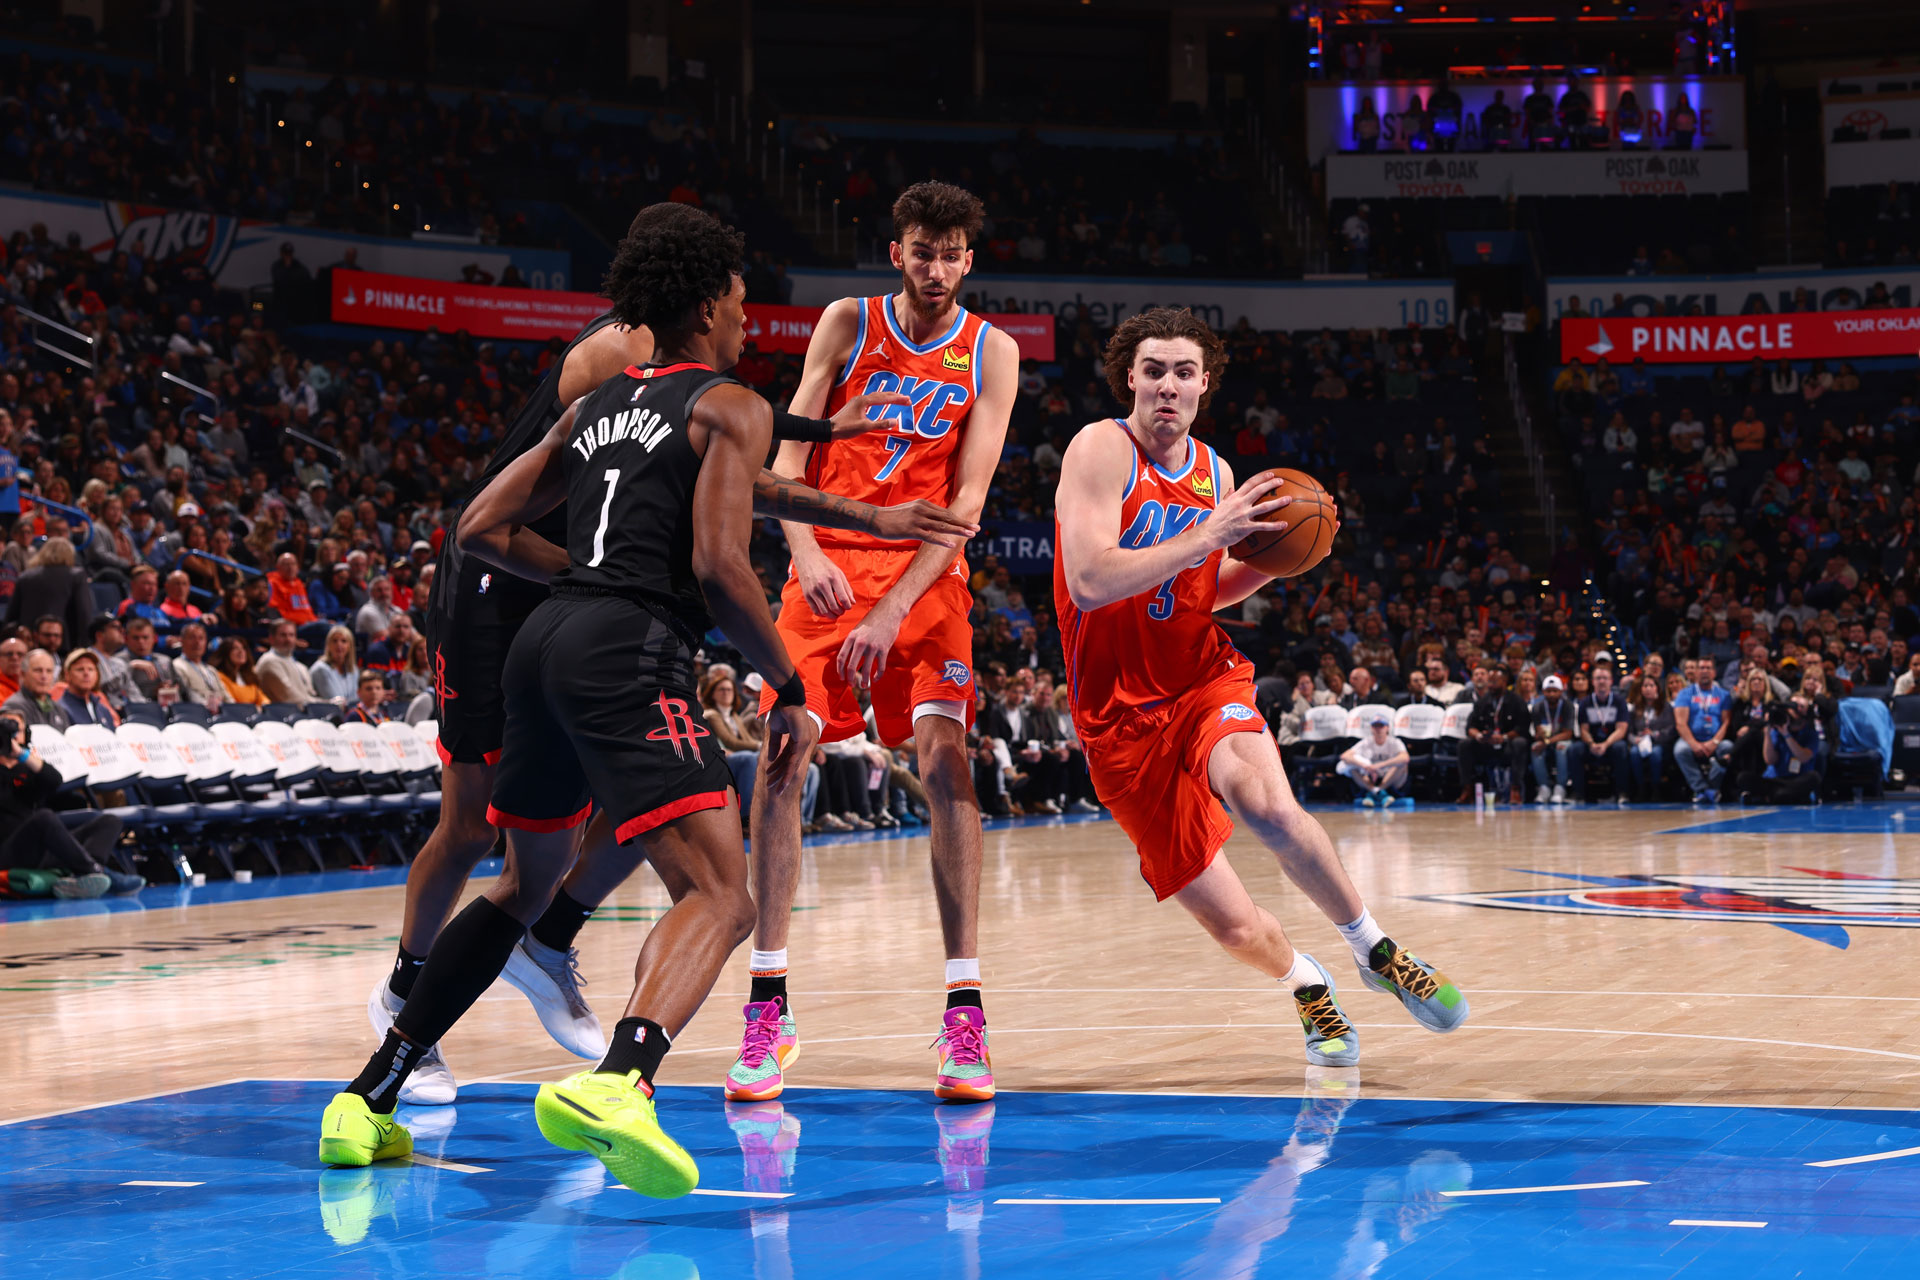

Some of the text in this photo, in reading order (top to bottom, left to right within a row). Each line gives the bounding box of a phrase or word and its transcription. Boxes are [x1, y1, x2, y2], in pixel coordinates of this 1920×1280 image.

[1384, 159, 1479, 181] POST OAK
[1605, 157, 1700, 178] POST OAK
[1396, 183, 1465, 197] TOYOTA
[1618, 179, 1687, 194] TOYOTA
[364, 288, 446, 315] PINNACLE
[1400, 298, 1448, 326] 109
[770, 319, 813, 338] PINN
[1632, 323, 1794, 353] PINNACLE
[1833, 318, 1875, 333] YOUR
[862, 370, 969, 439] OKC
[572, 408, 673, 462] THOMPSON
[873, 435, 912, 481] 7
[587, 468, 621, 567] 1
[1148, 575, 1177, 621] 3
